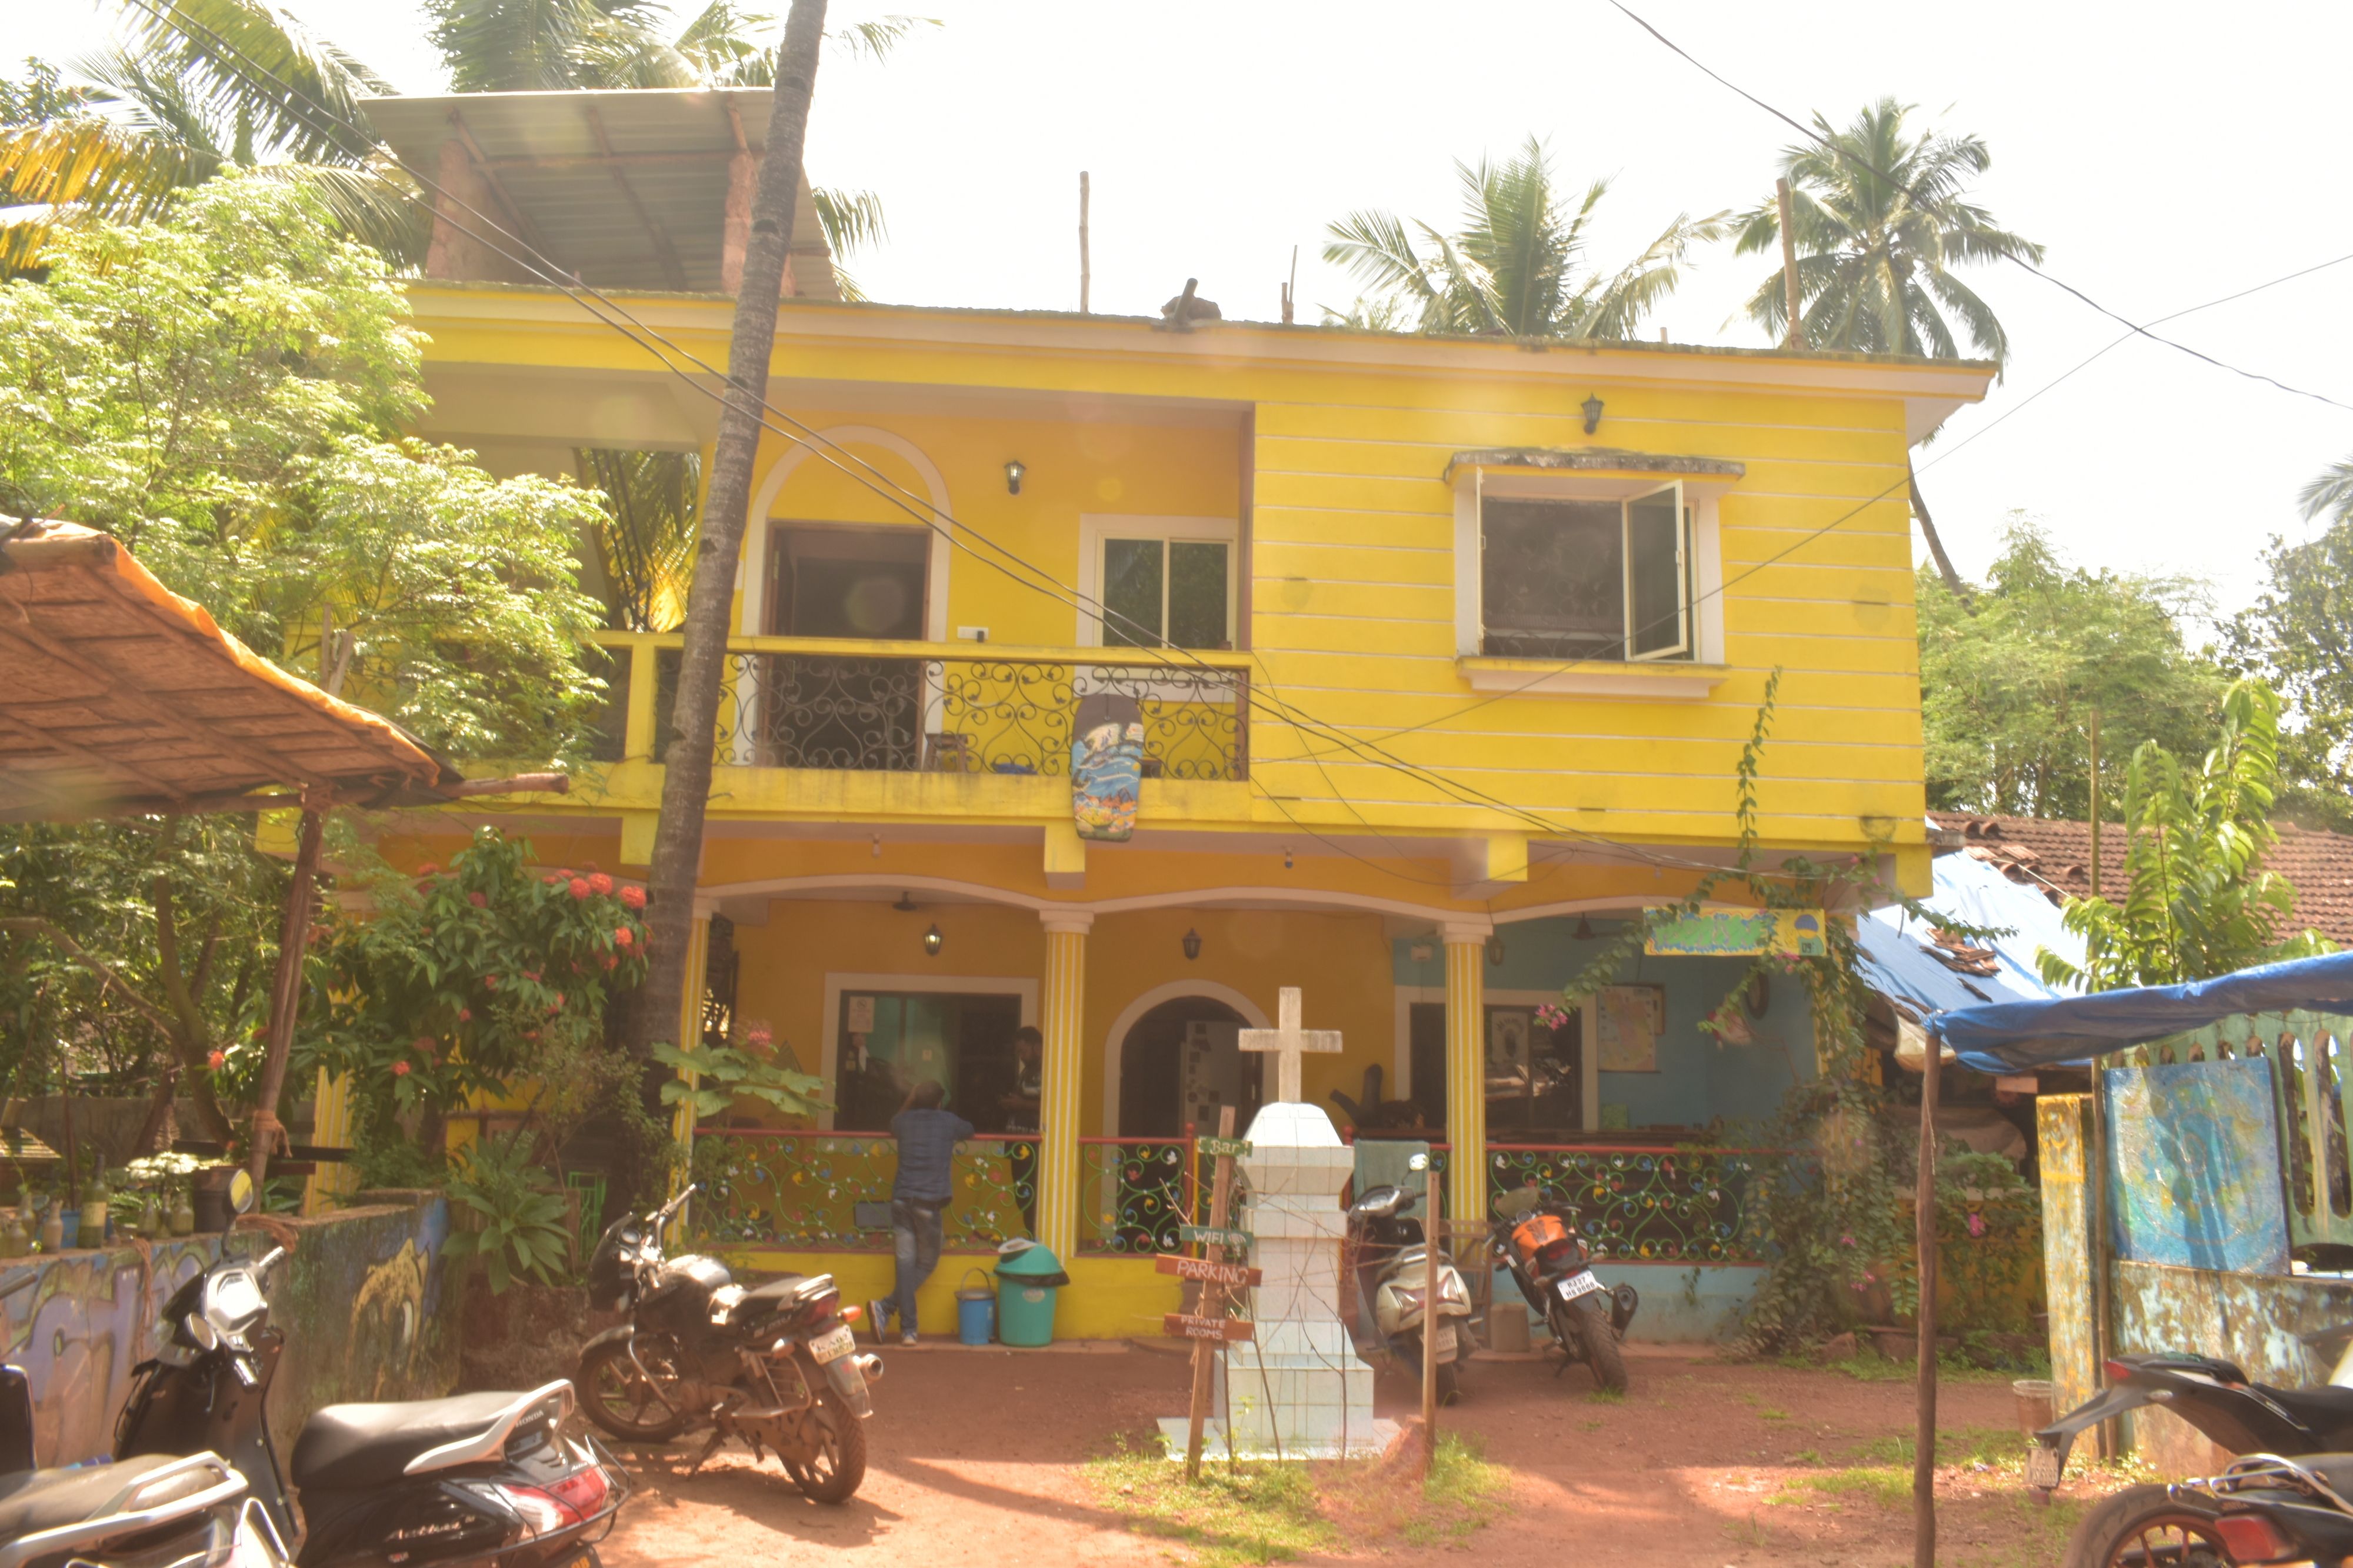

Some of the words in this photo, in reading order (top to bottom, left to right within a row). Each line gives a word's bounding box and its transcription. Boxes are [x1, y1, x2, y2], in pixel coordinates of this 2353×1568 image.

[1209, 1139, 1240, 1155] Bar
[1194, 1230, 1224, 1245] WIFI
[1177, 1260, 1248, 1285] PARKING
[1181, 1315, 1226, 1329] PRIVATE
[1185, 1327, 1223, 1340] ROOMS
[515, 1409, 544, 1428] HONDA
